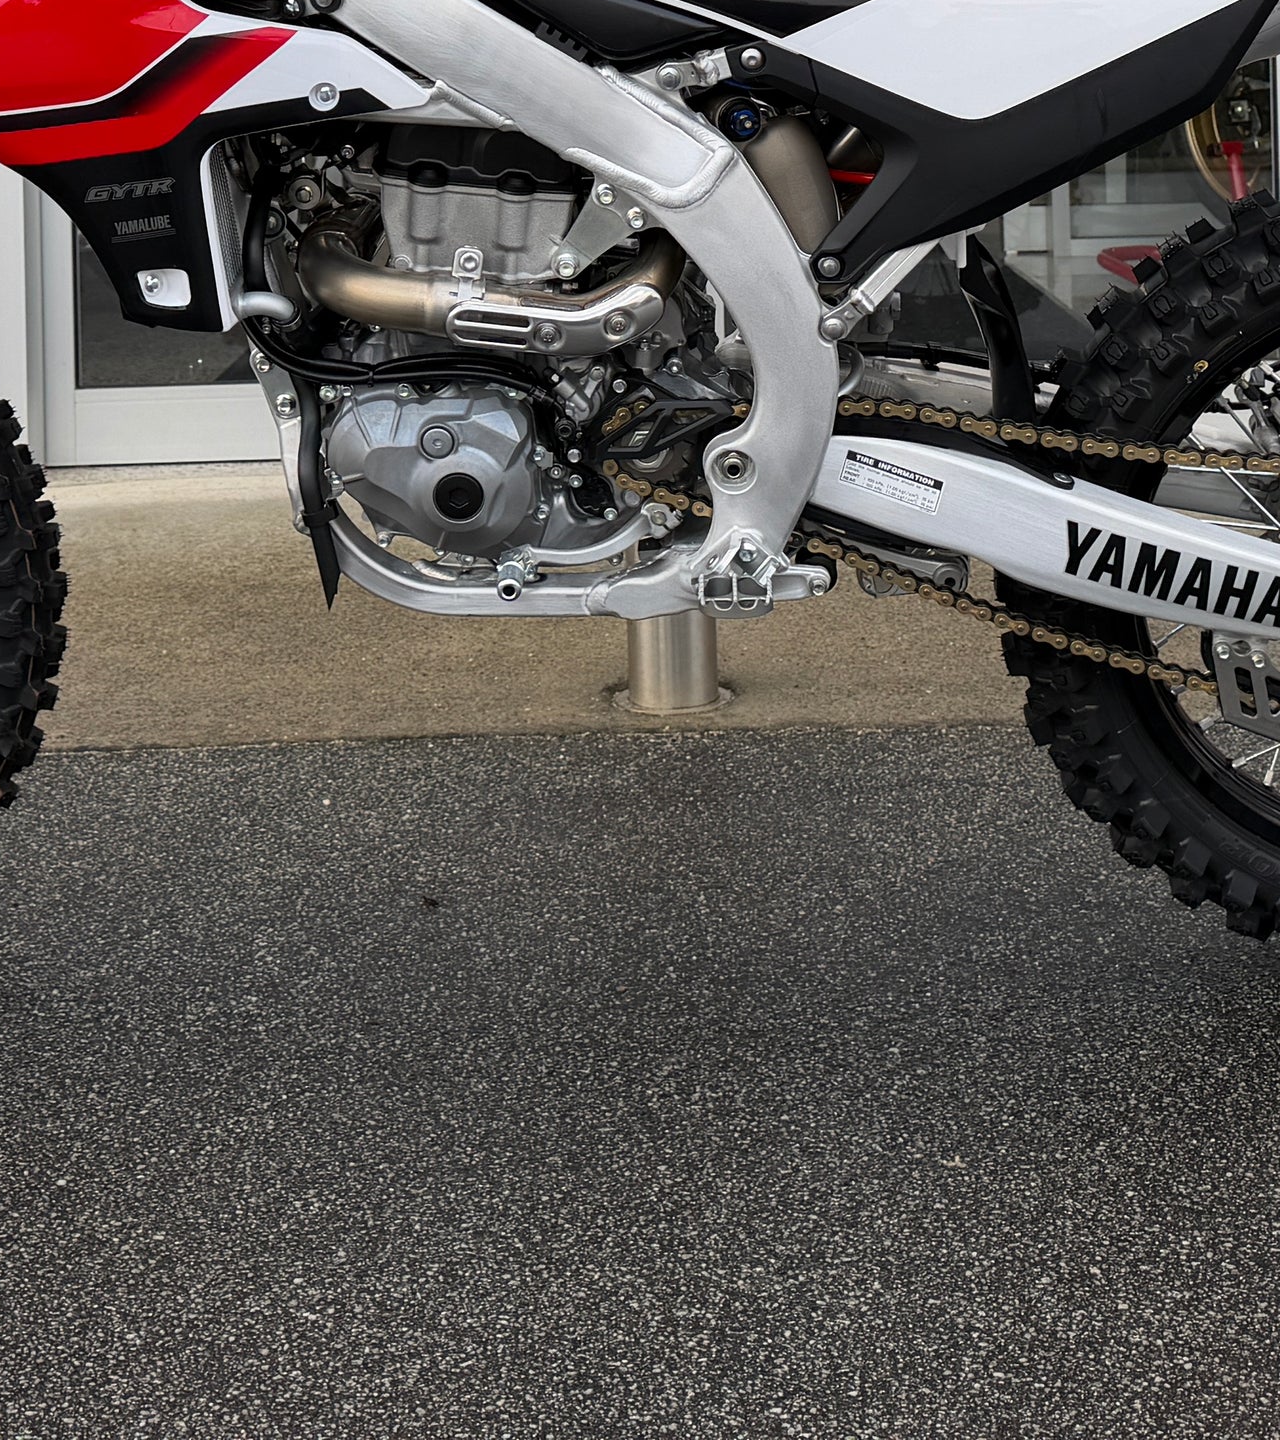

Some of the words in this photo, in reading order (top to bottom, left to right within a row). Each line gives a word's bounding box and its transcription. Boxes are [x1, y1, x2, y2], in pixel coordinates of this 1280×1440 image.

[84, 177, 176, 203] GYTR
[114, 215, 172, 235] YAMALUBE
[855, 454, 875, 466] TIRE
[878, 461, 935, 487] INFORMATION
